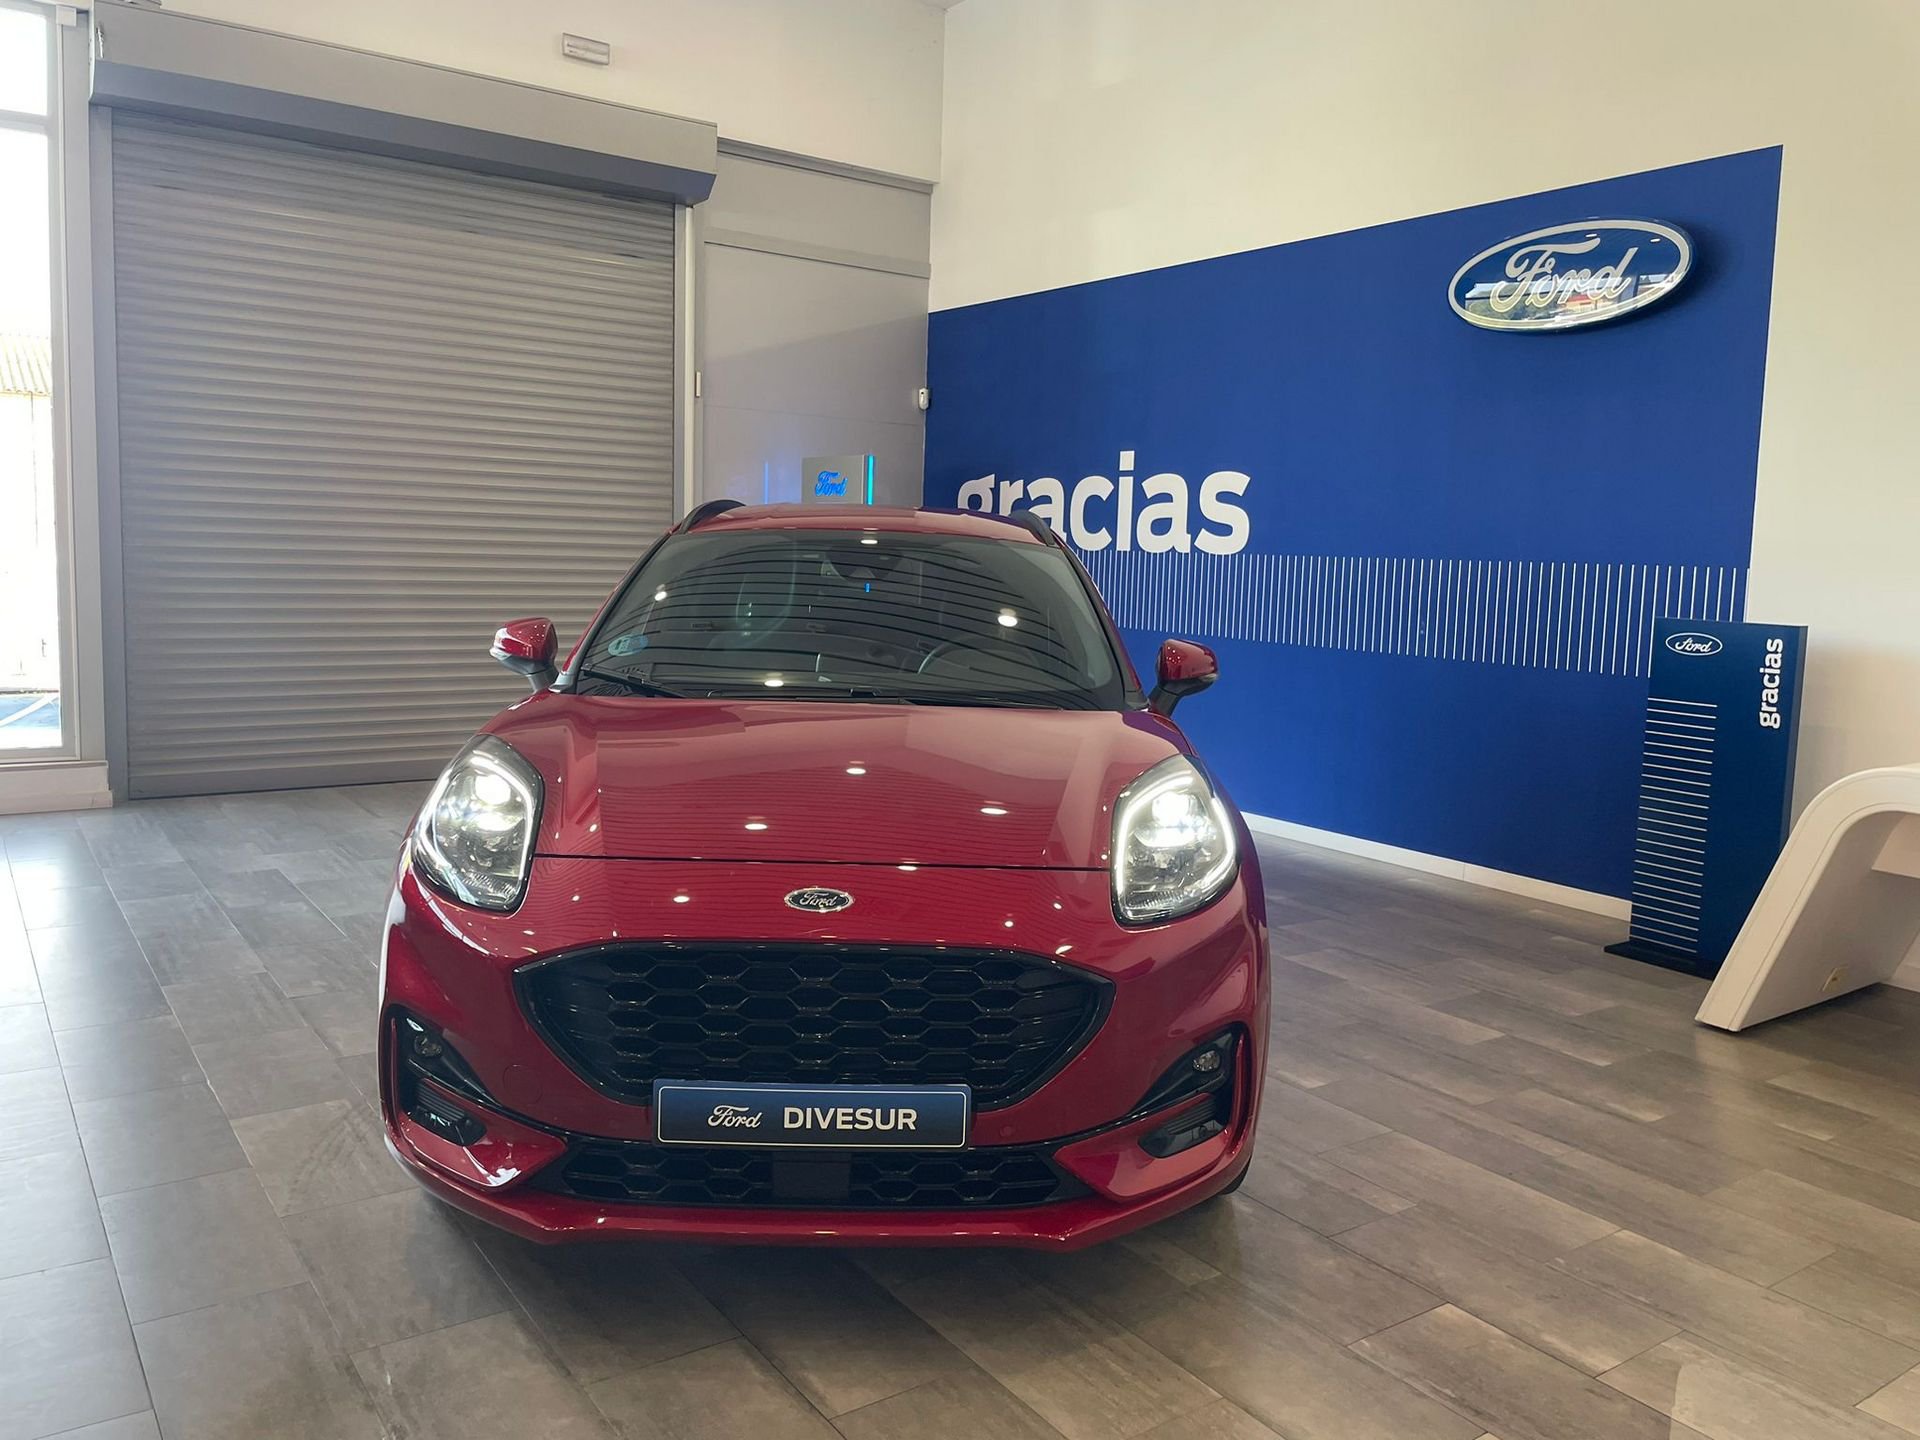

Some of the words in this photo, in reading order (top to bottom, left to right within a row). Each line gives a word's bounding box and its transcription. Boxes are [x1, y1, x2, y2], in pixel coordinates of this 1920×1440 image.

[1490, 237, 1638, 313] Ford
[815, 470, 847, 497] Ford
[1674, 637, 1713, 654] Ford
[1759, 638, 1783, 729] gracias
[799, 891, 838, 907] Ford
[707, 1104, 761, 1129] Ford
[783, 1106, 918, 1131] DIVESUR
